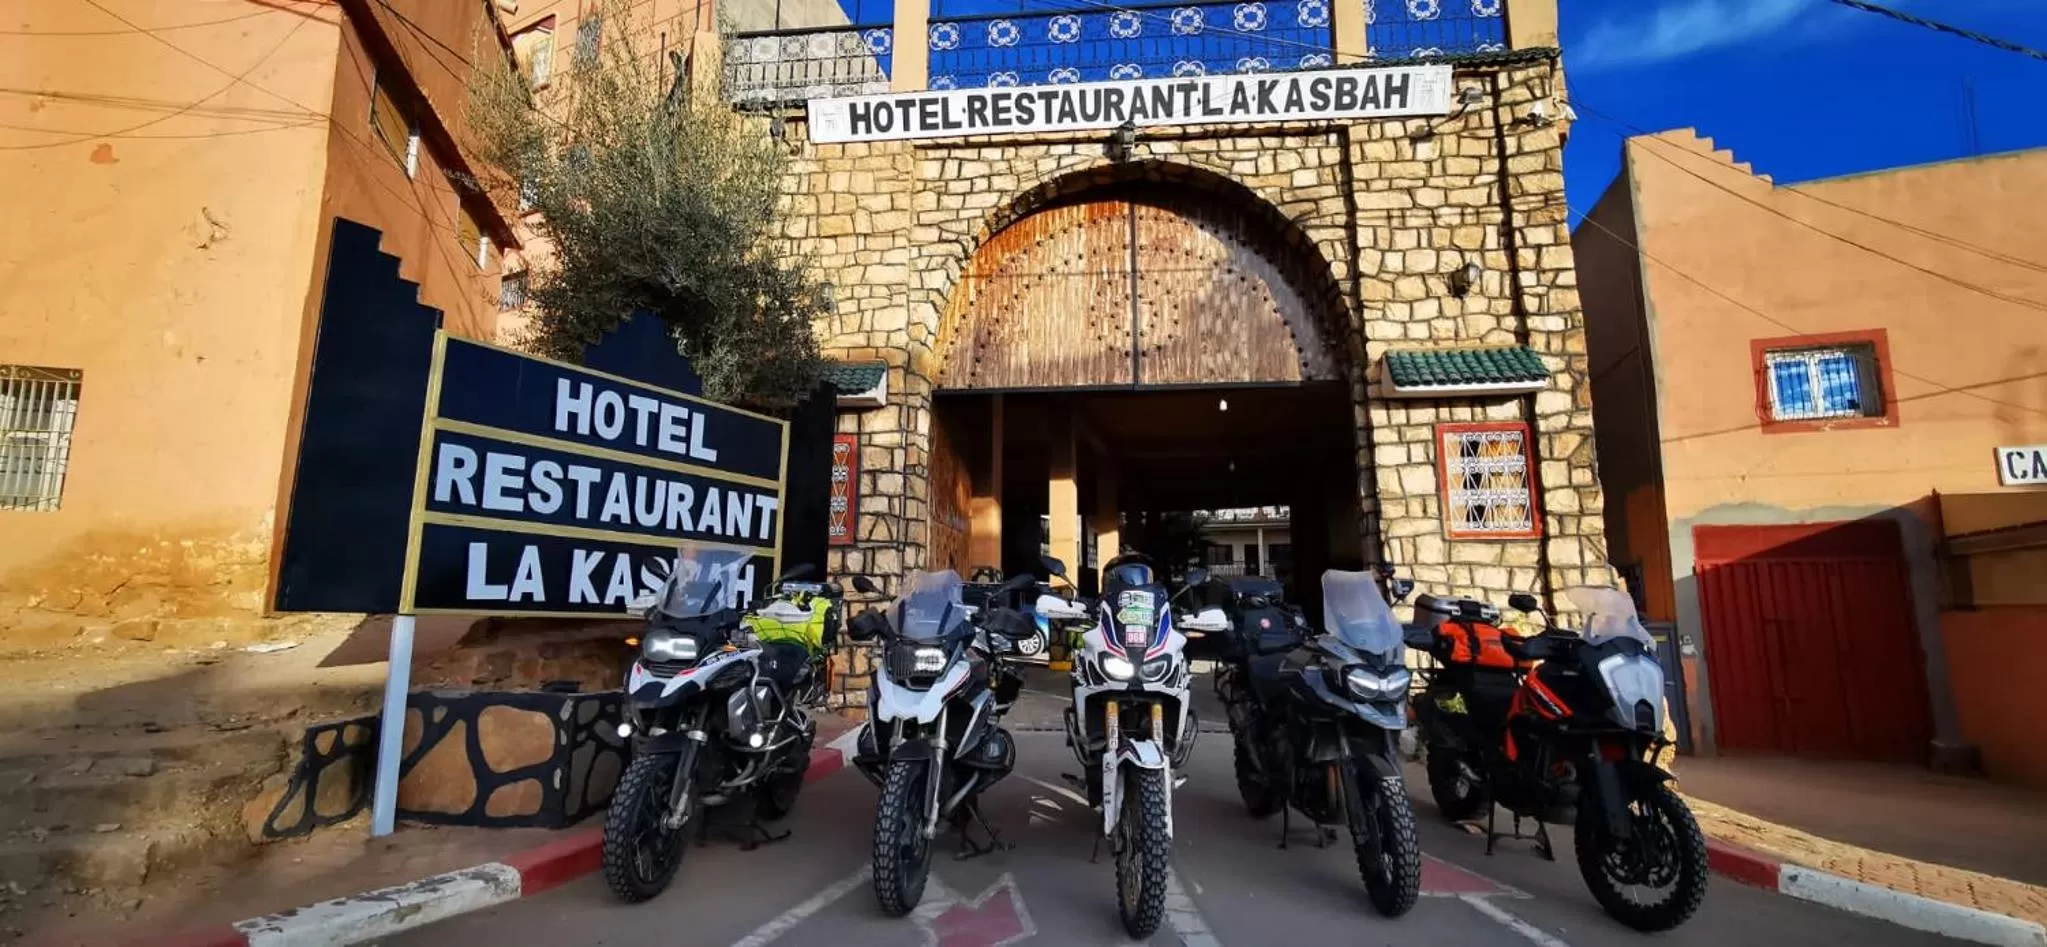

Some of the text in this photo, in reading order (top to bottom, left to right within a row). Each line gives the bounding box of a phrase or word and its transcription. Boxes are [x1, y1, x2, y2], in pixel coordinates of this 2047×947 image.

[849, 97, 963, 135] HOTEL
[1257, 73, 1410, 114] KASBAH
[555, 377, 718, 462] HOTEL
[434, 443, 778, 540] RESTAURANT
[466, 542, 546, 601] LA
